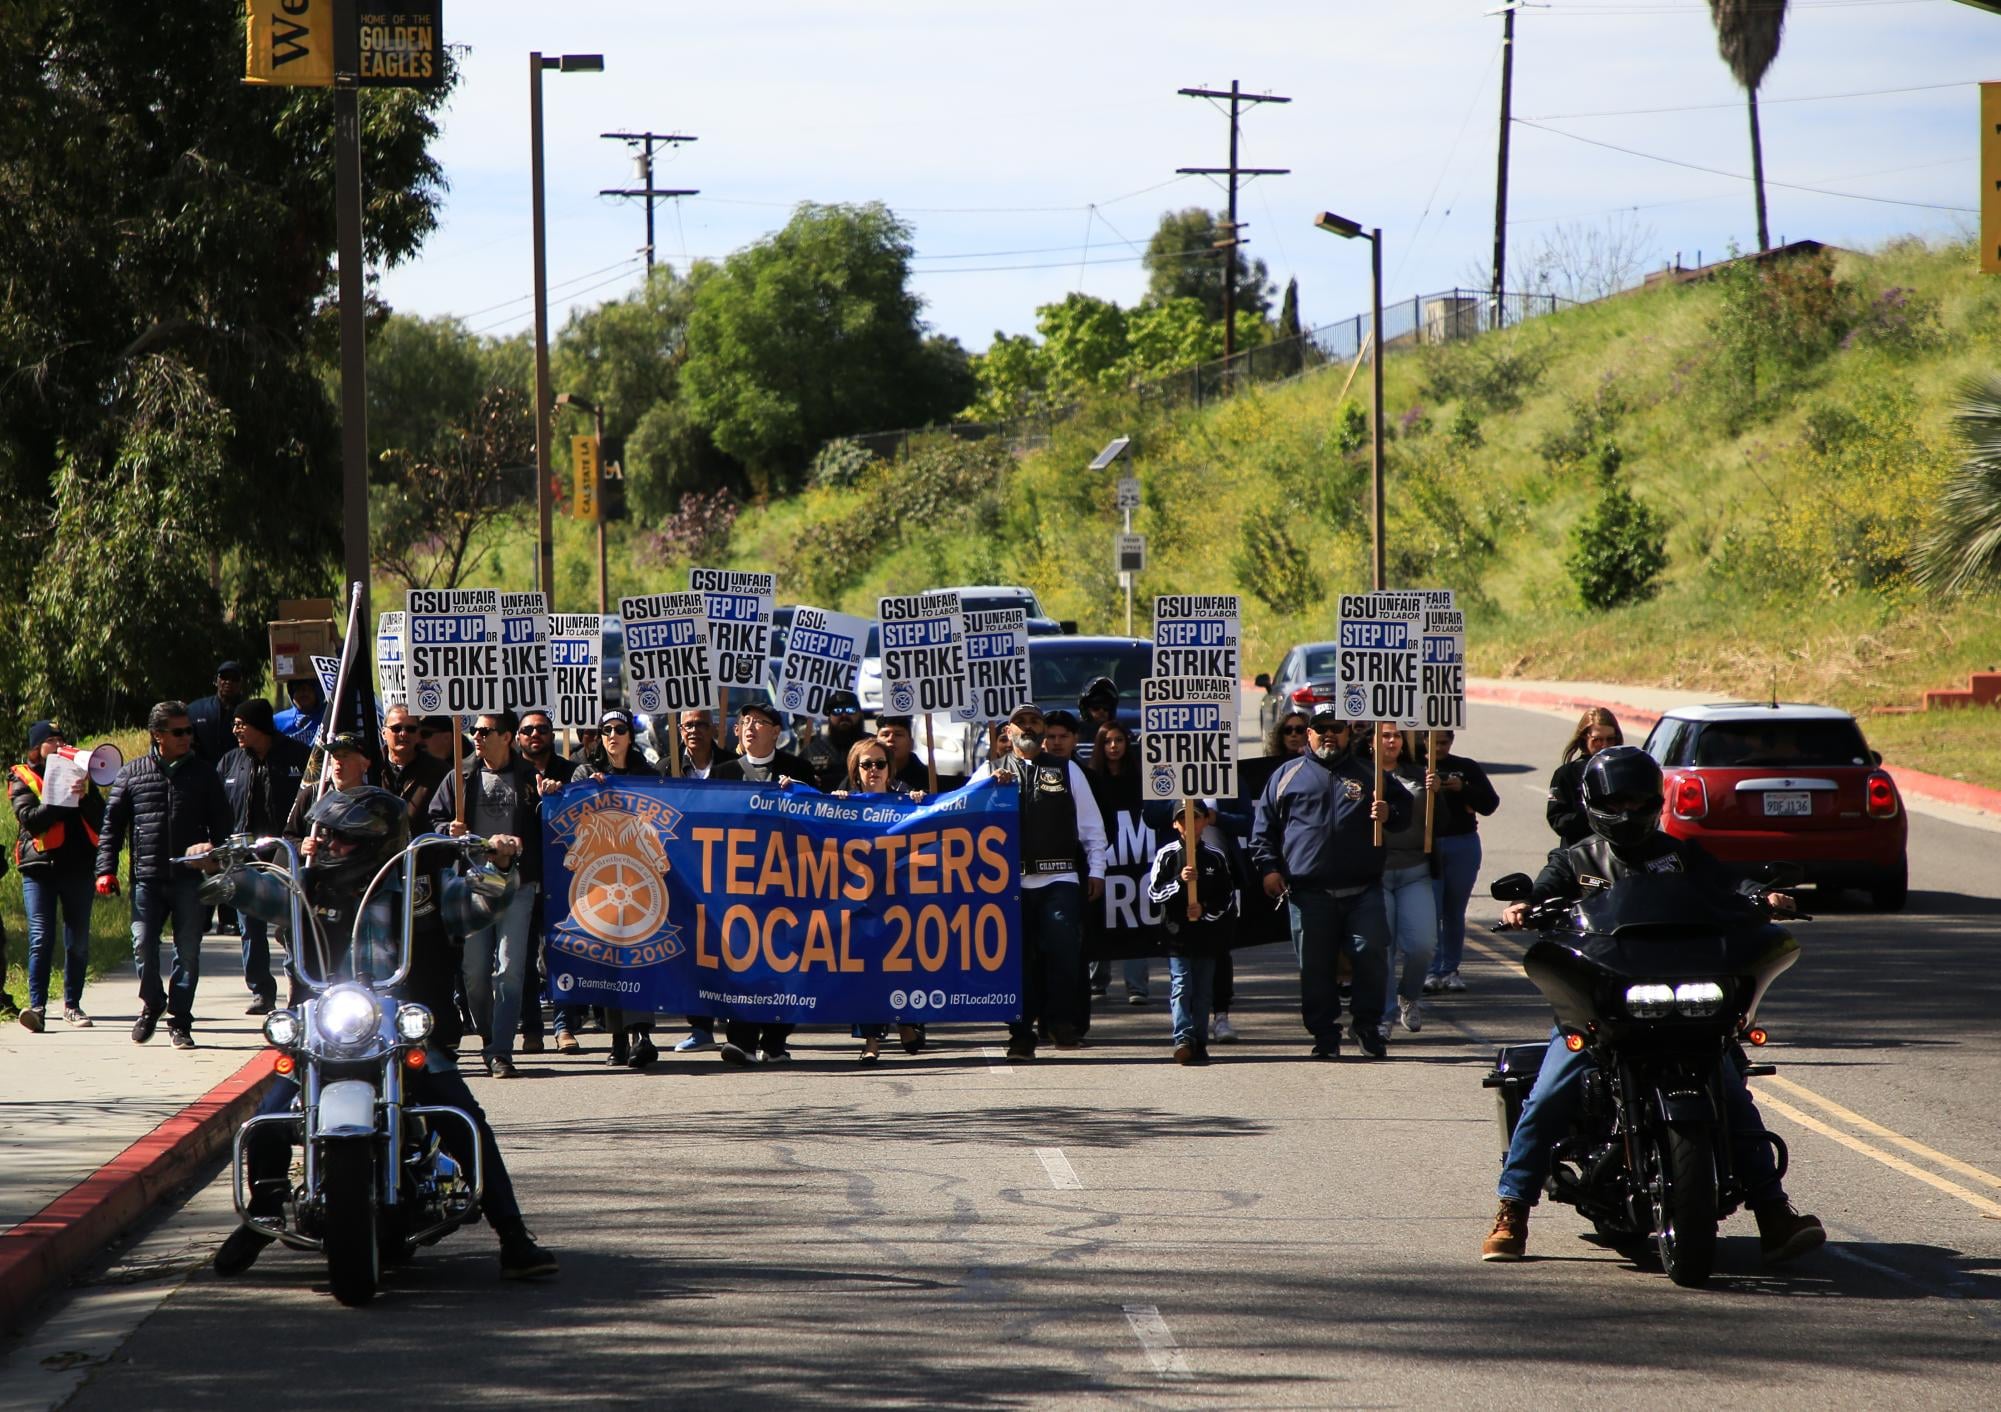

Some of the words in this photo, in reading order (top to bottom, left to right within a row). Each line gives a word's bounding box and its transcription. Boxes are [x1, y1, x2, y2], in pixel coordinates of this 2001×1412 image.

[360, 15, 386, 24] HOME
[392, 15, 406, 24] OF
[414, 15, 431, 24] THE
[360, 26, 432, 50] GOLDEN
[360, 52, 432, 77] EAGLES
[581, 441, 590, 455] LA
[1120, 495, 1140, 507] 25
[692, 570, 729, 592] CSU
[731, 573, 771, 587] UNFAIR
[743, 587, 771, 595] LABOR
[410, 591, 450, 613] CSU
[453, 590, 496, 605] UNFAIR
[453, 605, 465, 613] TO
[467, 604, 497, 612] LABOR
[501, 594, 543, 608] UNFAIR
[622, 597, 661, 621] CSU
[662, 594, 702, 610] UNFAIR
[705, 597, 732, 618] TEP
[735, 598, 757, 619] UP
[759, 613, 768, 622] OR
[881, 598, 919, 620] CSU
[920, 593, 958, 610] UNFAIR
[1157, 597, 1193, 618] CSU
[1195, 597, 1237, 610] UNFAIR
[1341, 596, 1376, 618] CSU
[1379, 598, 1420, 612] UNFAIR
[1426, 592, 1450, 604] FAIR
[502, 608, 512, 616] TO
[676, 607, 703, 616] LABOR
[797, 609, 827, 630] CSU:
[934, 607, 960, 616] LABOR
[963, 613, 983, 633] SU
[985, 610, 1022, 625] UNFAIR
[1208, 610, 1237, 618] LABOR
[1391, 612, 1420, 620] LABOR
[1431, 612, 1462, 625] UNFAIR
[414, 619, 455, 642] STEP
[461, 618, 485, 640] UP
[487, 632, 497, 642] OR
[509, 620, 531, 641] UP
[535, 632, 546, 642] OR
[549, 616, 564, 636] SU
[566, 616, 599, 628] UNFAIR
[628, 626, 666, 649] STEP
[672, 623, 694, 644] UP
[697, 635, 706, 645] OR
[885, 622, 925, 647] STEP
[929, 620, 950, 643] UP
[952, 633, 962, 643] OR
[998, 622, 1024, 631] LABOR
[1158, 623, 1197, 645] STEP
[1200, 623, 1223, 644] UP
[1226, 636, 1237, 647] OR
[1342, 623, 1381, 647] STEP
[1384, 625, 1406, 647] UP
[1408, 639, 1418, 649] OR
[1442, 625, 1463, 633] LABOR
[551, 643, 567, 663] EP
[570, 643, 588, 663] UP
[590, 656, 598, 665] OR
[792, 630, 829, 653] STEP
[830, 637, 851, 658] UP
[851, 653, 860, 663] OR
[967, 636, 989, 657] EP
[992, 635, 1012, 655] UP
[1016, 646, 1025, 656] OR
[1436, 640, 1454, 661] UP
[1455, 653, 1463, 663] OR
[315, 658, 341, 673] CS
[413, 645, 498, 678] STRIKE
[502, 646, 547, 676] RIKE
[629, 647, 709, 681] STRIKE
[785, 653, 857, 691] STRIKE
[886, 645, 964, 680] STRIKE
[968, 658, 1026, 688] TRIKE
[1157, 649, 1236, 678] STRIKE
[1341, 651, 1418, 683] STRIKE
[380, 664, 406, 691] STRIKE
[553, 667, 597, 694] RIKE
[1423, 665, 1462, 694] RIKE
[449, 677, 498, 711] OUT
[503, 675, 549, 708] OUT
[665, 675, 711, 709] OUT
[920, 676, 965, 710] OUT
[984, 686, 1027, 717] OUT
[1144, 679, 1184, 701] CSU
[1187, 679, 1230, 693] UNFAIR
[1201, 693, 1231, 701] LABOR
[1372, 684, 1418, 718] OUT
[561, 695, 598, 725] OUT
[1147, 707, 1189, 730] STEP
[1193, 707, 1217, 729] UP
[1220, 720, 1231, 731] OR
[1427, 695, 1463, 727] OUT
[1146, 733, 1231, 763] STRIKE
[1182, 763, 1232, 796] OUT
[556, 793, 674, 828] TEAMSTERS
[750, 794, 778, 811] Our
[778, 797, 811, 815] Work
[814, 804, 858, 820] Makes
[692, 826, 1009, 901] TEAMSTERS
[1039, 862, 1067, 870] CHAPTER
[562, 935, 624, 964] LOCAL
[630, 939, 676, 964] 2010
[696, 903, 864, 973] LOCAL
[882, 903, 1008, 973] 2010
[577, 977, 641, 993] Teamsters2010
[699, 989, 817, 1008] www.teamsters2010.org
[950, 994, 1016, 1006] IBTLocal2010
